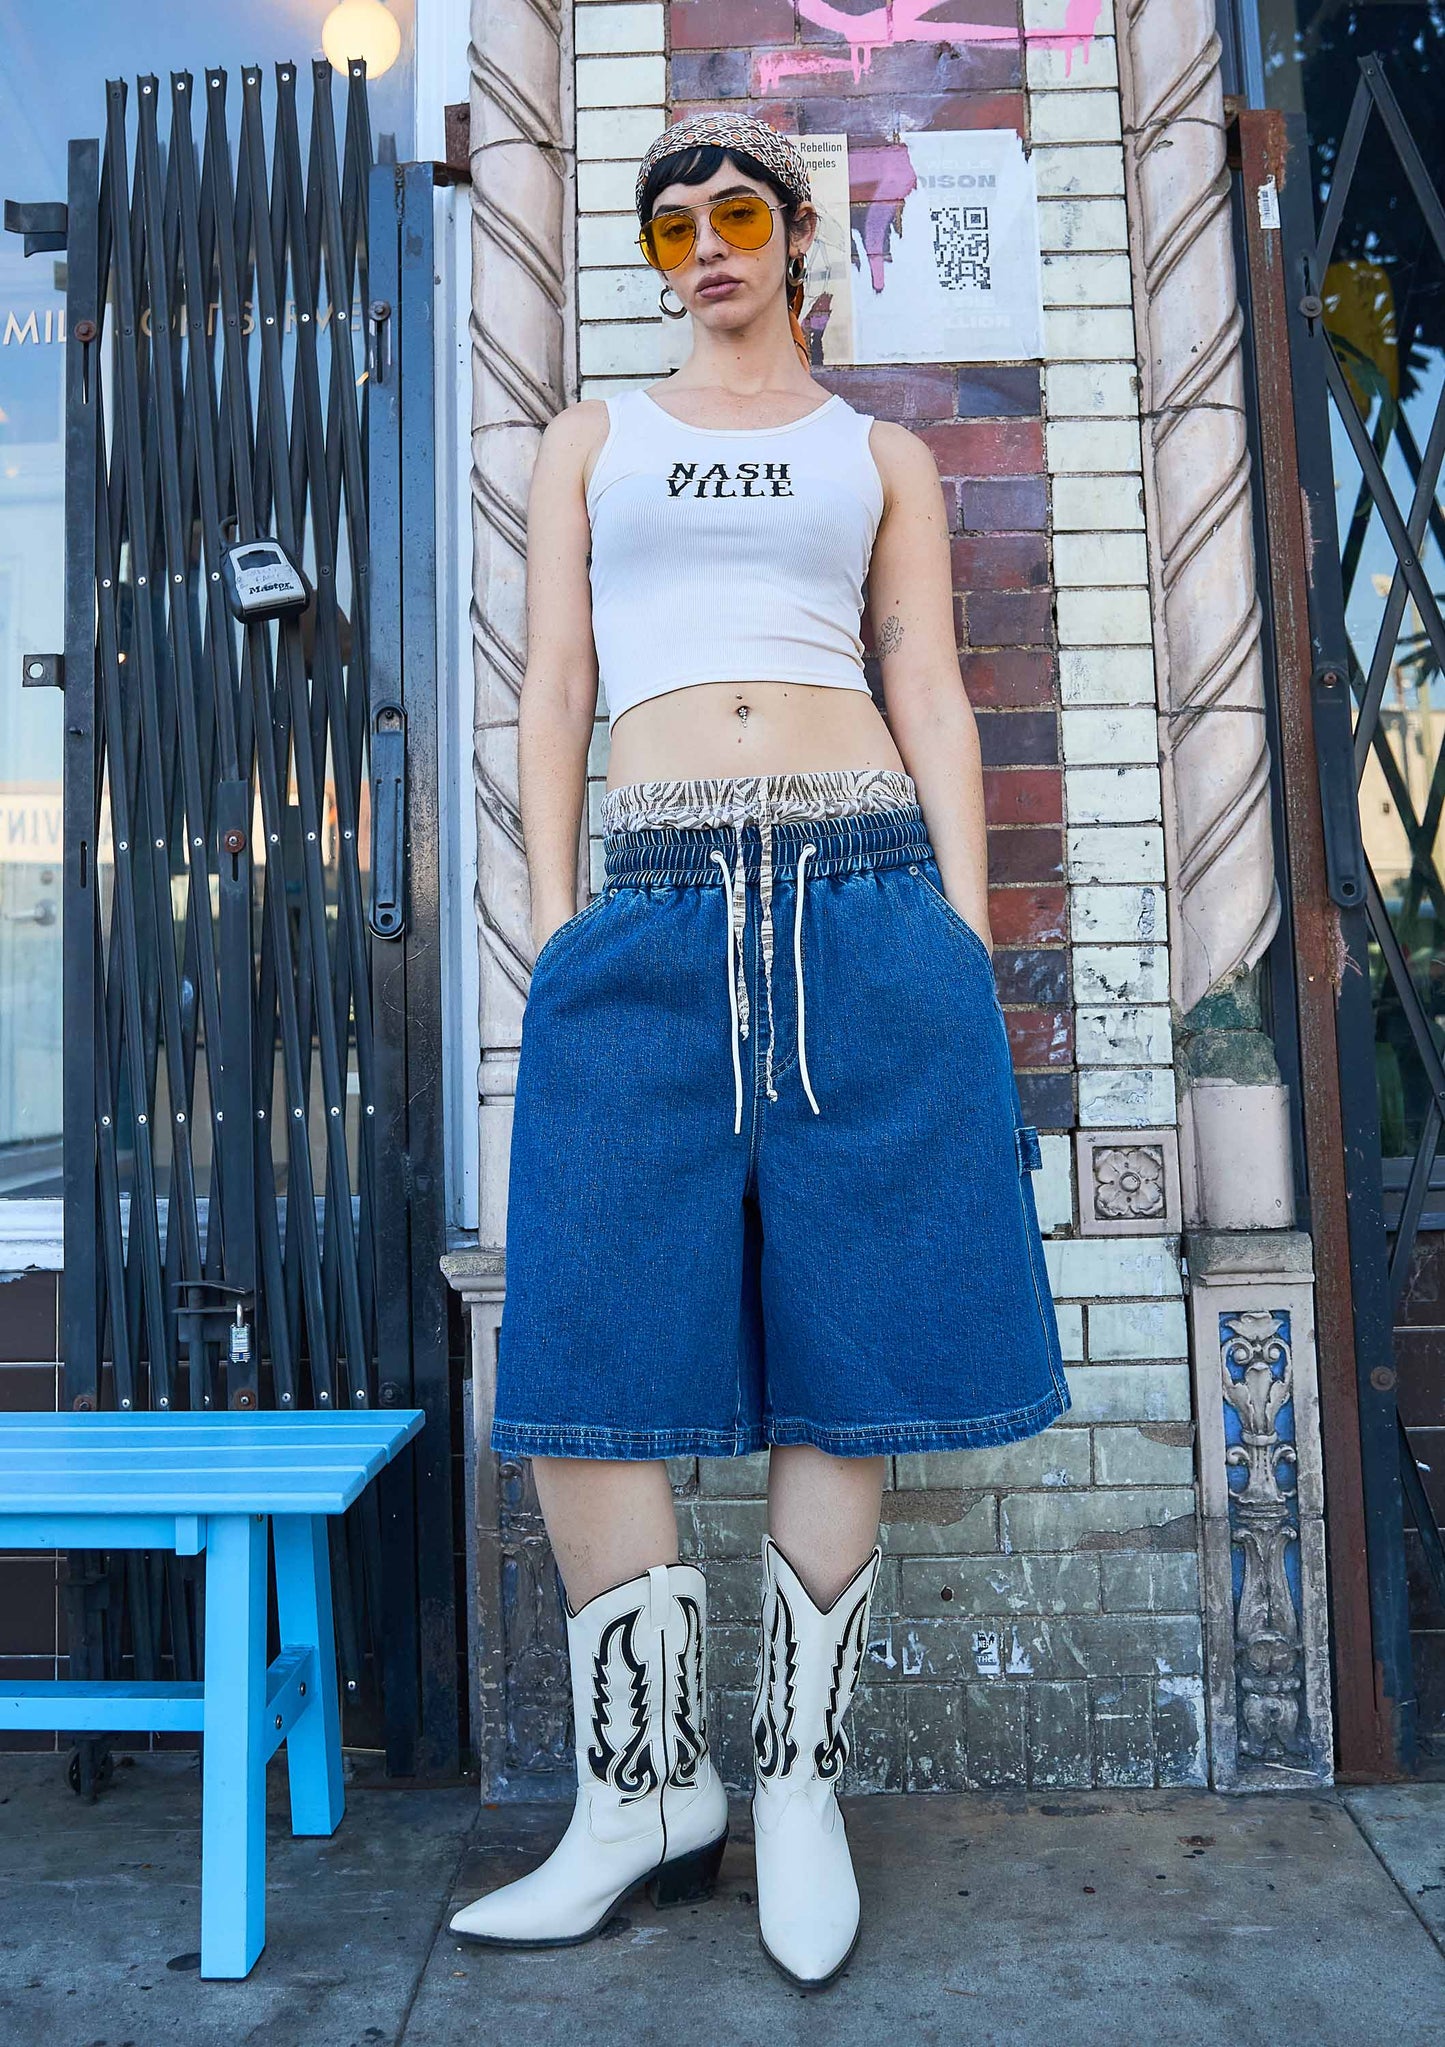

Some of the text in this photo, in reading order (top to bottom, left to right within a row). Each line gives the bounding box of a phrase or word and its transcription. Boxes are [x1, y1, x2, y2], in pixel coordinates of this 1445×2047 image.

[800, 142, 842, 152] Rebellion
[804, 158, 836, 171] ngeles
[3, 310, 67, 345] MIL
[668, 462, 791, 480] NASH
[666, 479, 794, 498] VILLE
